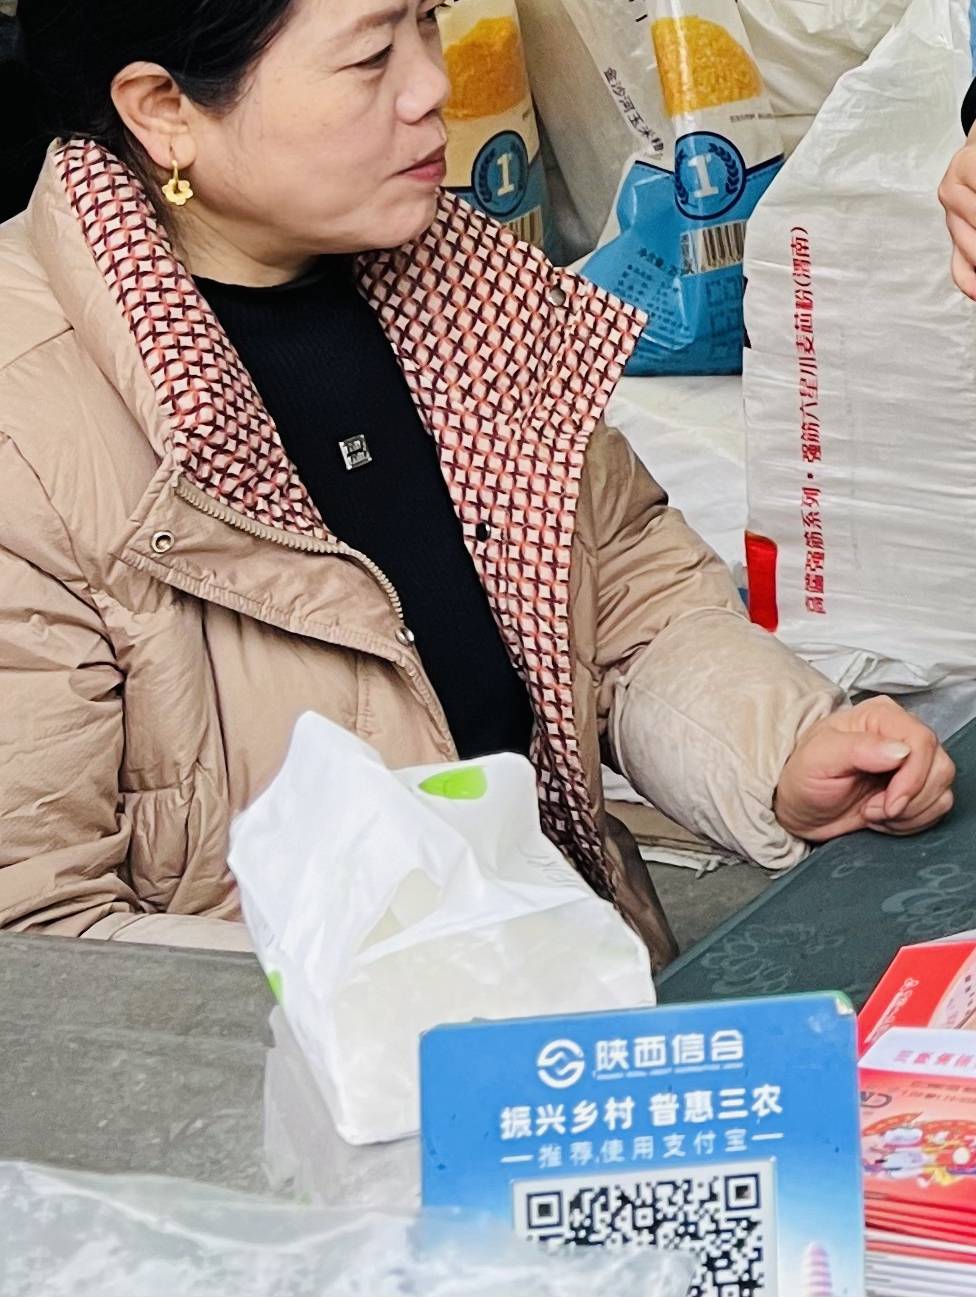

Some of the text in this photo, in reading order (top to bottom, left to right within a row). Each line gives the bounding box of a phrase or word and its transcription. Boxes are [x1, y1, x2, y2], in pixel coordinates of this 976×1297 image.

[593, 1028, 745, 1072] 陕西信合
[500, 1083, 783, 1140] 振兴乡村 普惠三农
